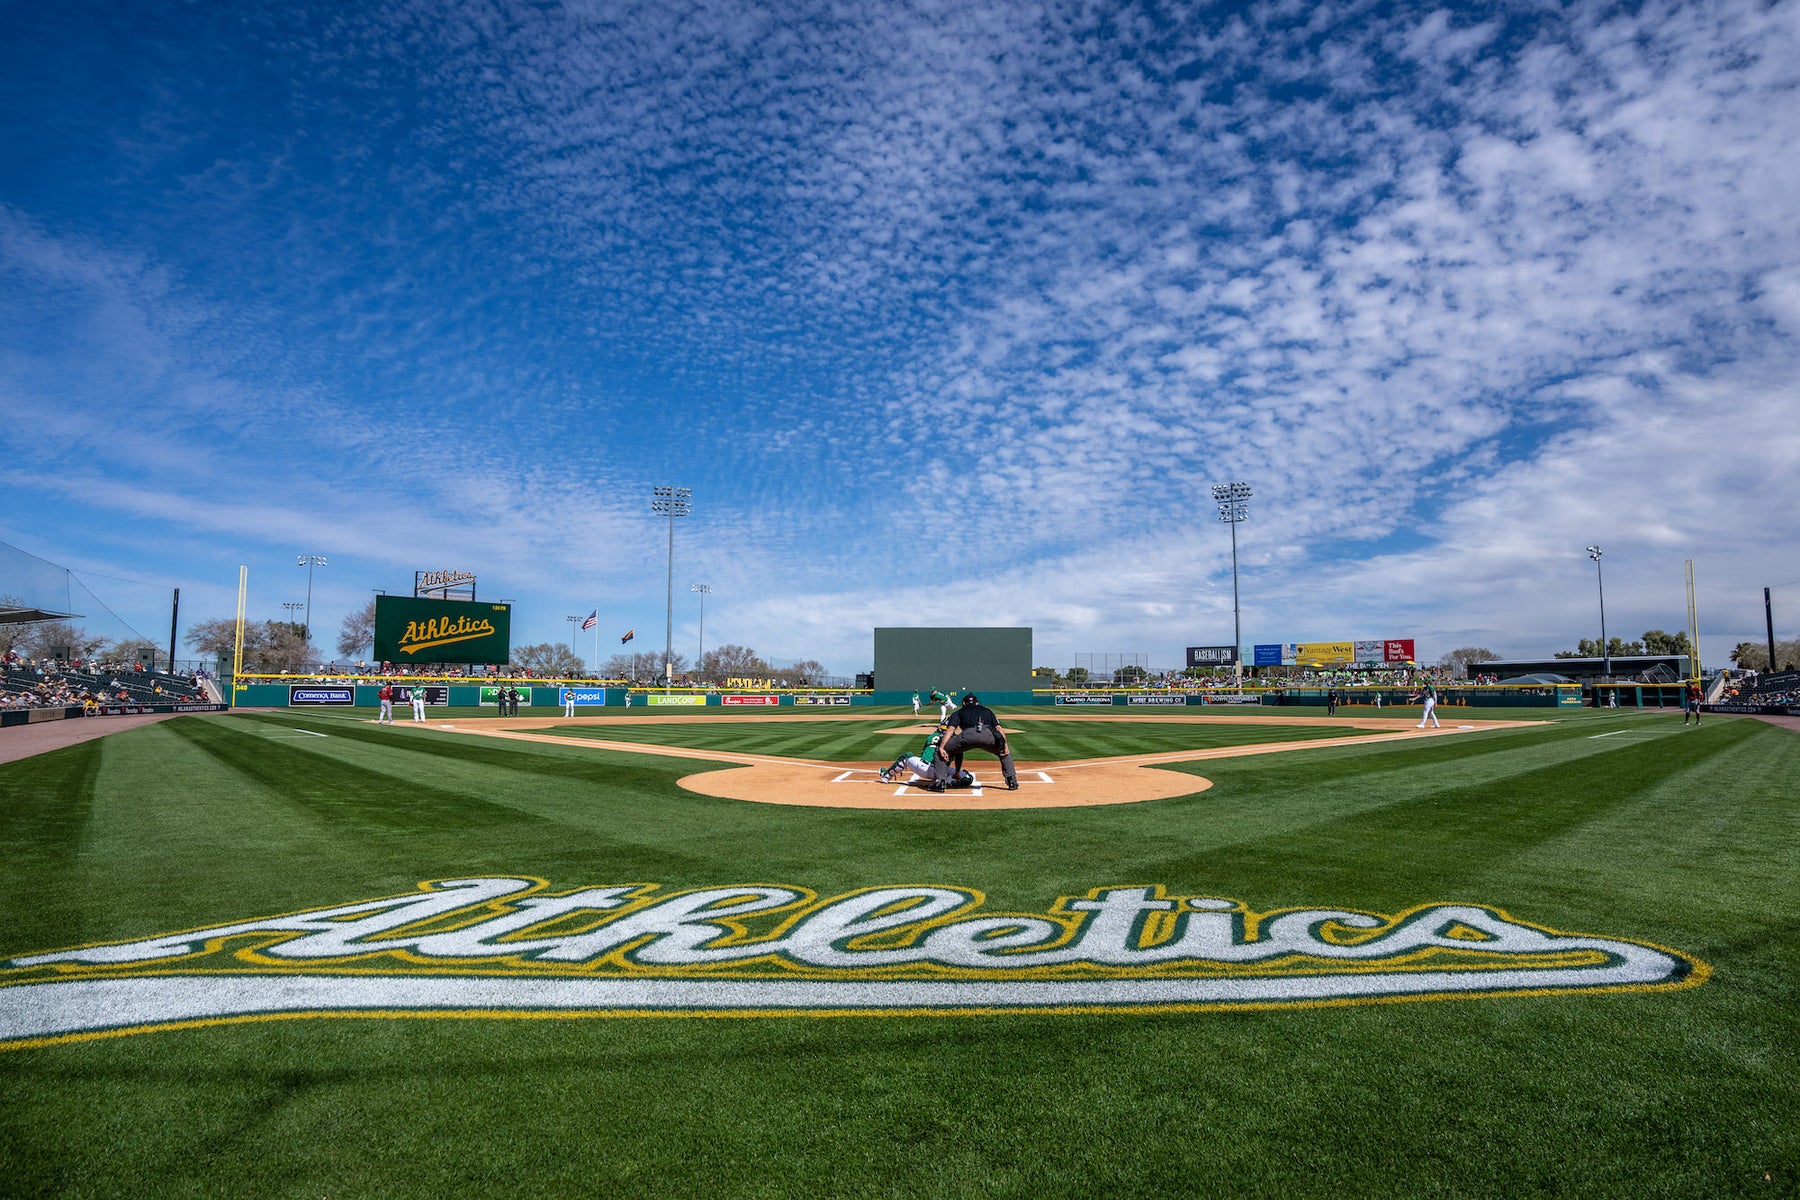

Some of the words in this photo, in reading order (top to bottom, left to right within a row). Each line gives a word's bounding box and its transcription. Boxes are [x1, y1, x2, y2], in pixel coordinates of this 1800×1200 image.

[417, 569, 476, 590] Athletics
[398, 615, 495, 649] Athletics
[1194, 649, 1232, 663] BASEBALLISM
[330, 691, 347, 699] Bank
[577, 691, 600, 701] pepsi
[8, 876, 1708, 990] Athletics
